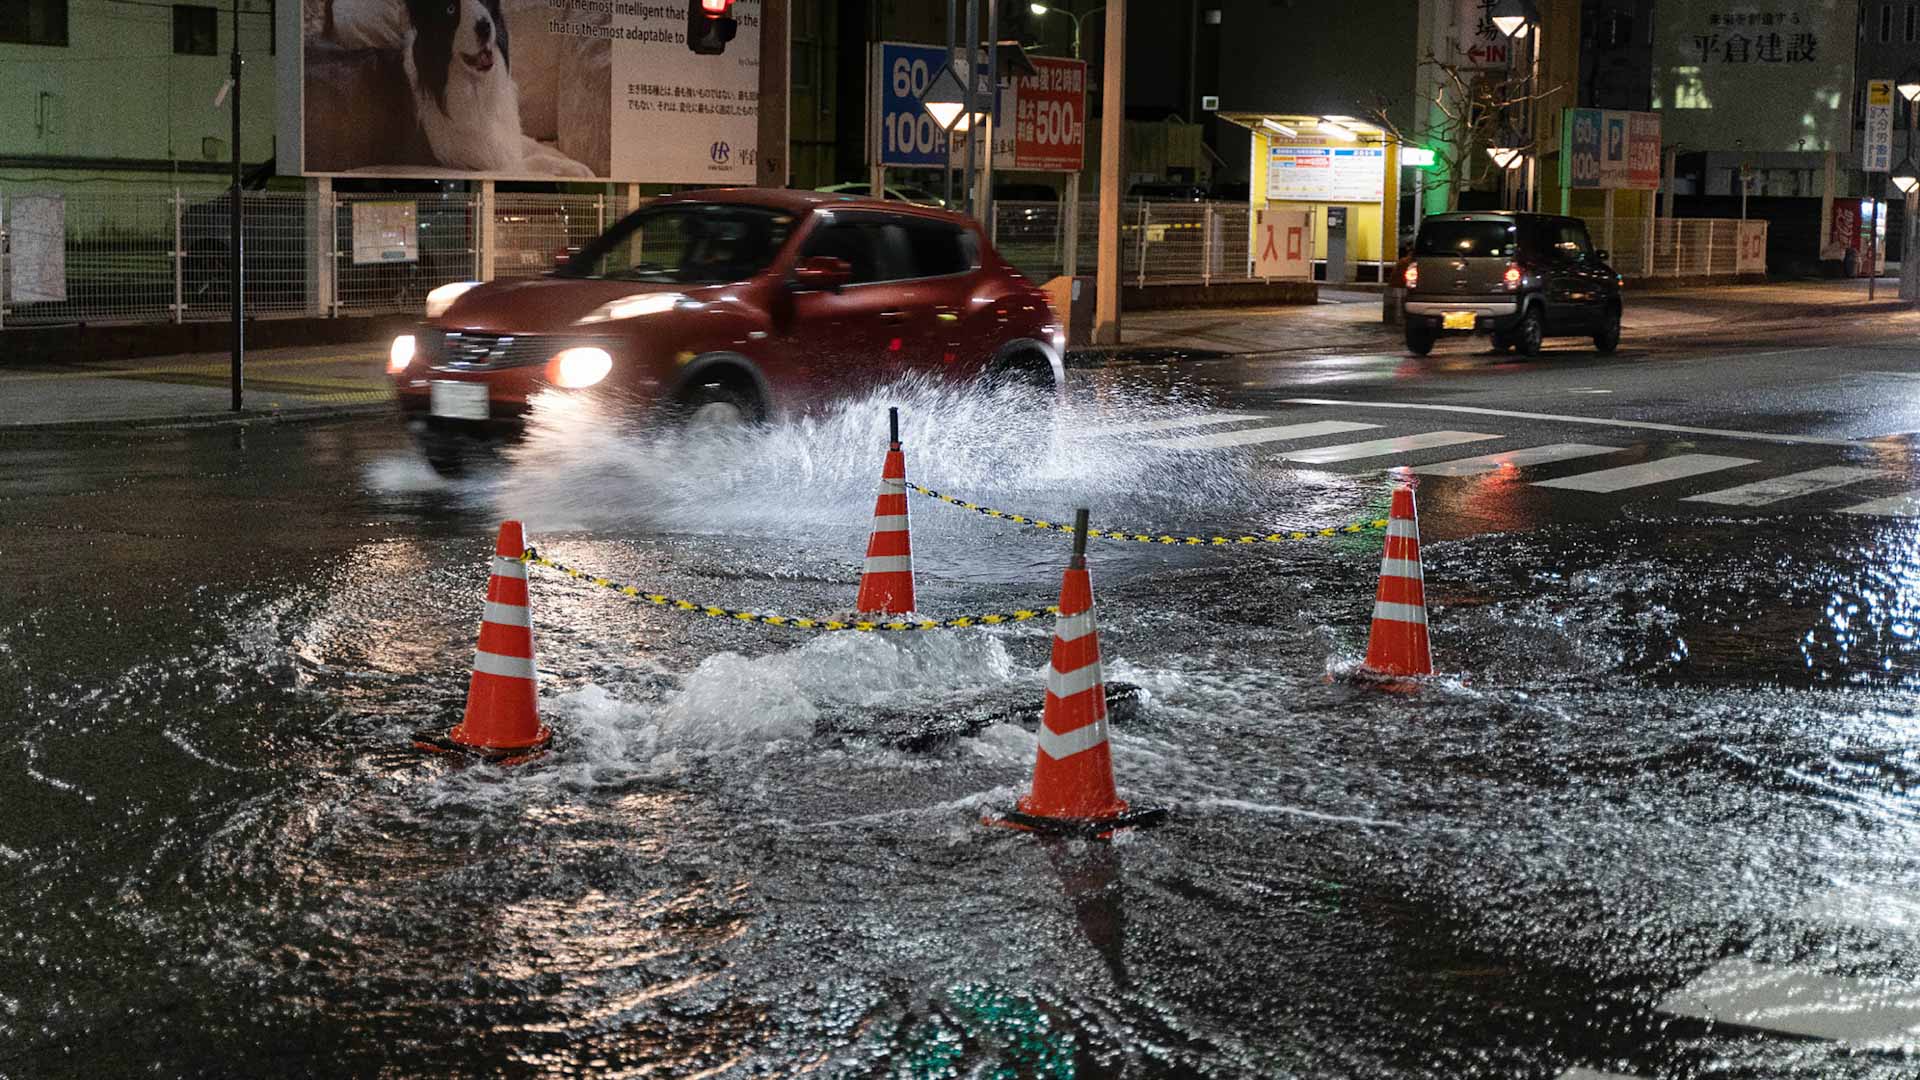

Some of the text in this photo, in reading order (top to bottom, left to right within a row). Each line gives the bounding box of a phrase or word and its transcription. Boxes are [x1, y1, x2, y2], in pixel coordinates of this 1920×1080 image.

[567, 0, 587, 12] the
[589, 0, 614, 14] most
[615, 2, 665, 20] intelligent
[666, 6, 685, 21] that
[744, 13, 759, 27] the
[549, 19, 685, 45] that is the most adaptable to
[1693, 32, 1817, 62] 平倉建設
[1487, 45, 1506, 63] IN
[893, 57, 935, 98] 60
[1036, 100, 1082, 145] 500円
[1263, 224, 1302, 261] 入口
